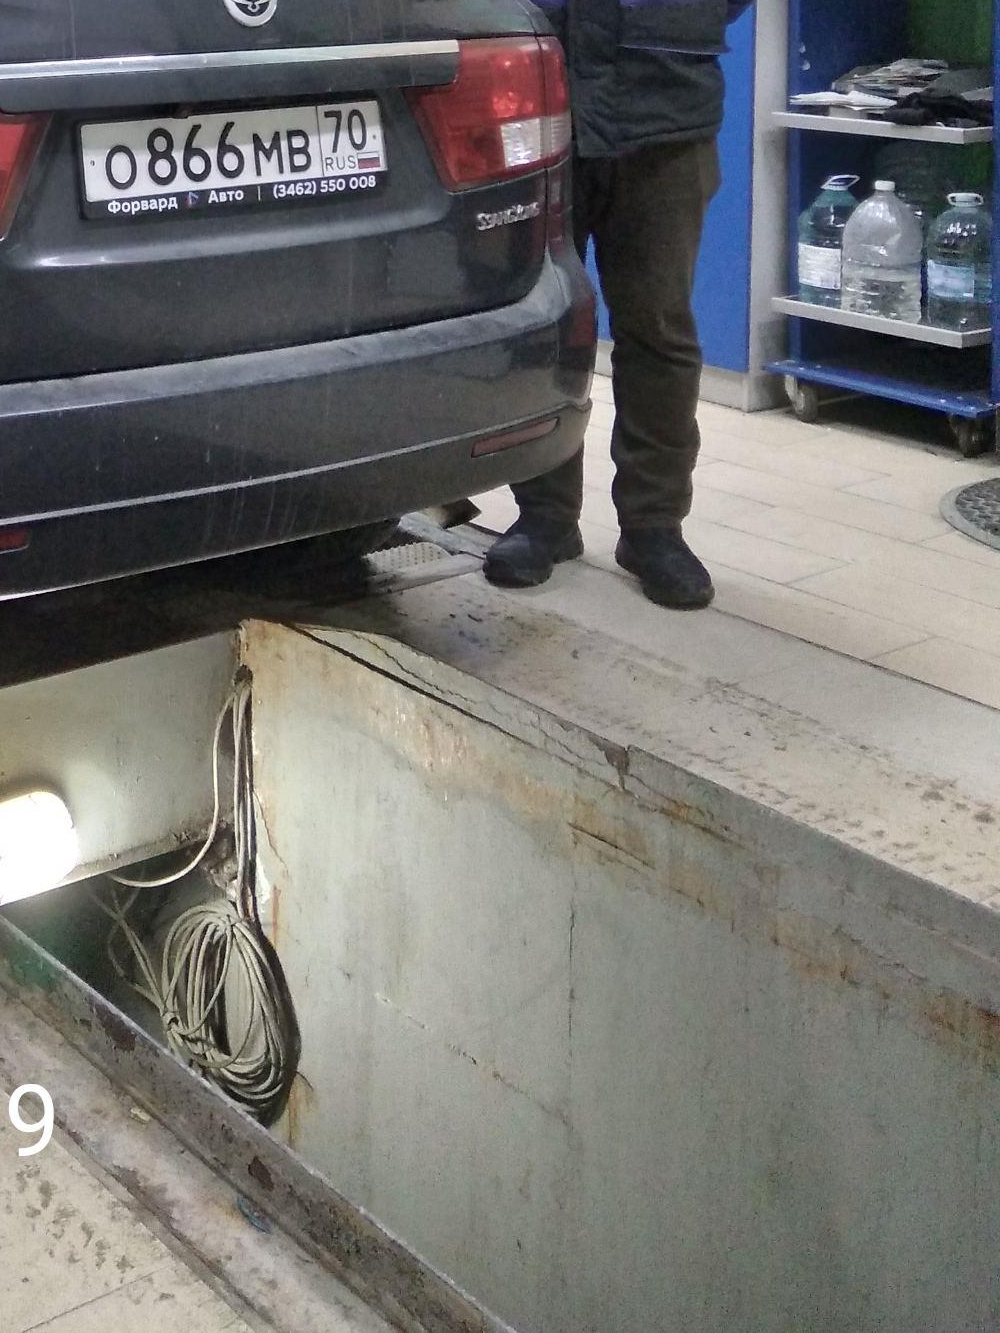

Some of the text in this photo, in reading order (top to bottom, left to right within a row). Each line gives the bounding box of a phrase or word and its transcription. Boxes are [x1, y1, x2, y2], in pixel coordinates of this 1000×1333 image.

[324, 109, 368, 153] 70
[325, 155, 356, 172] RUS
[107, 175, 377, 215] Форвард Авто (3462) 550 008
